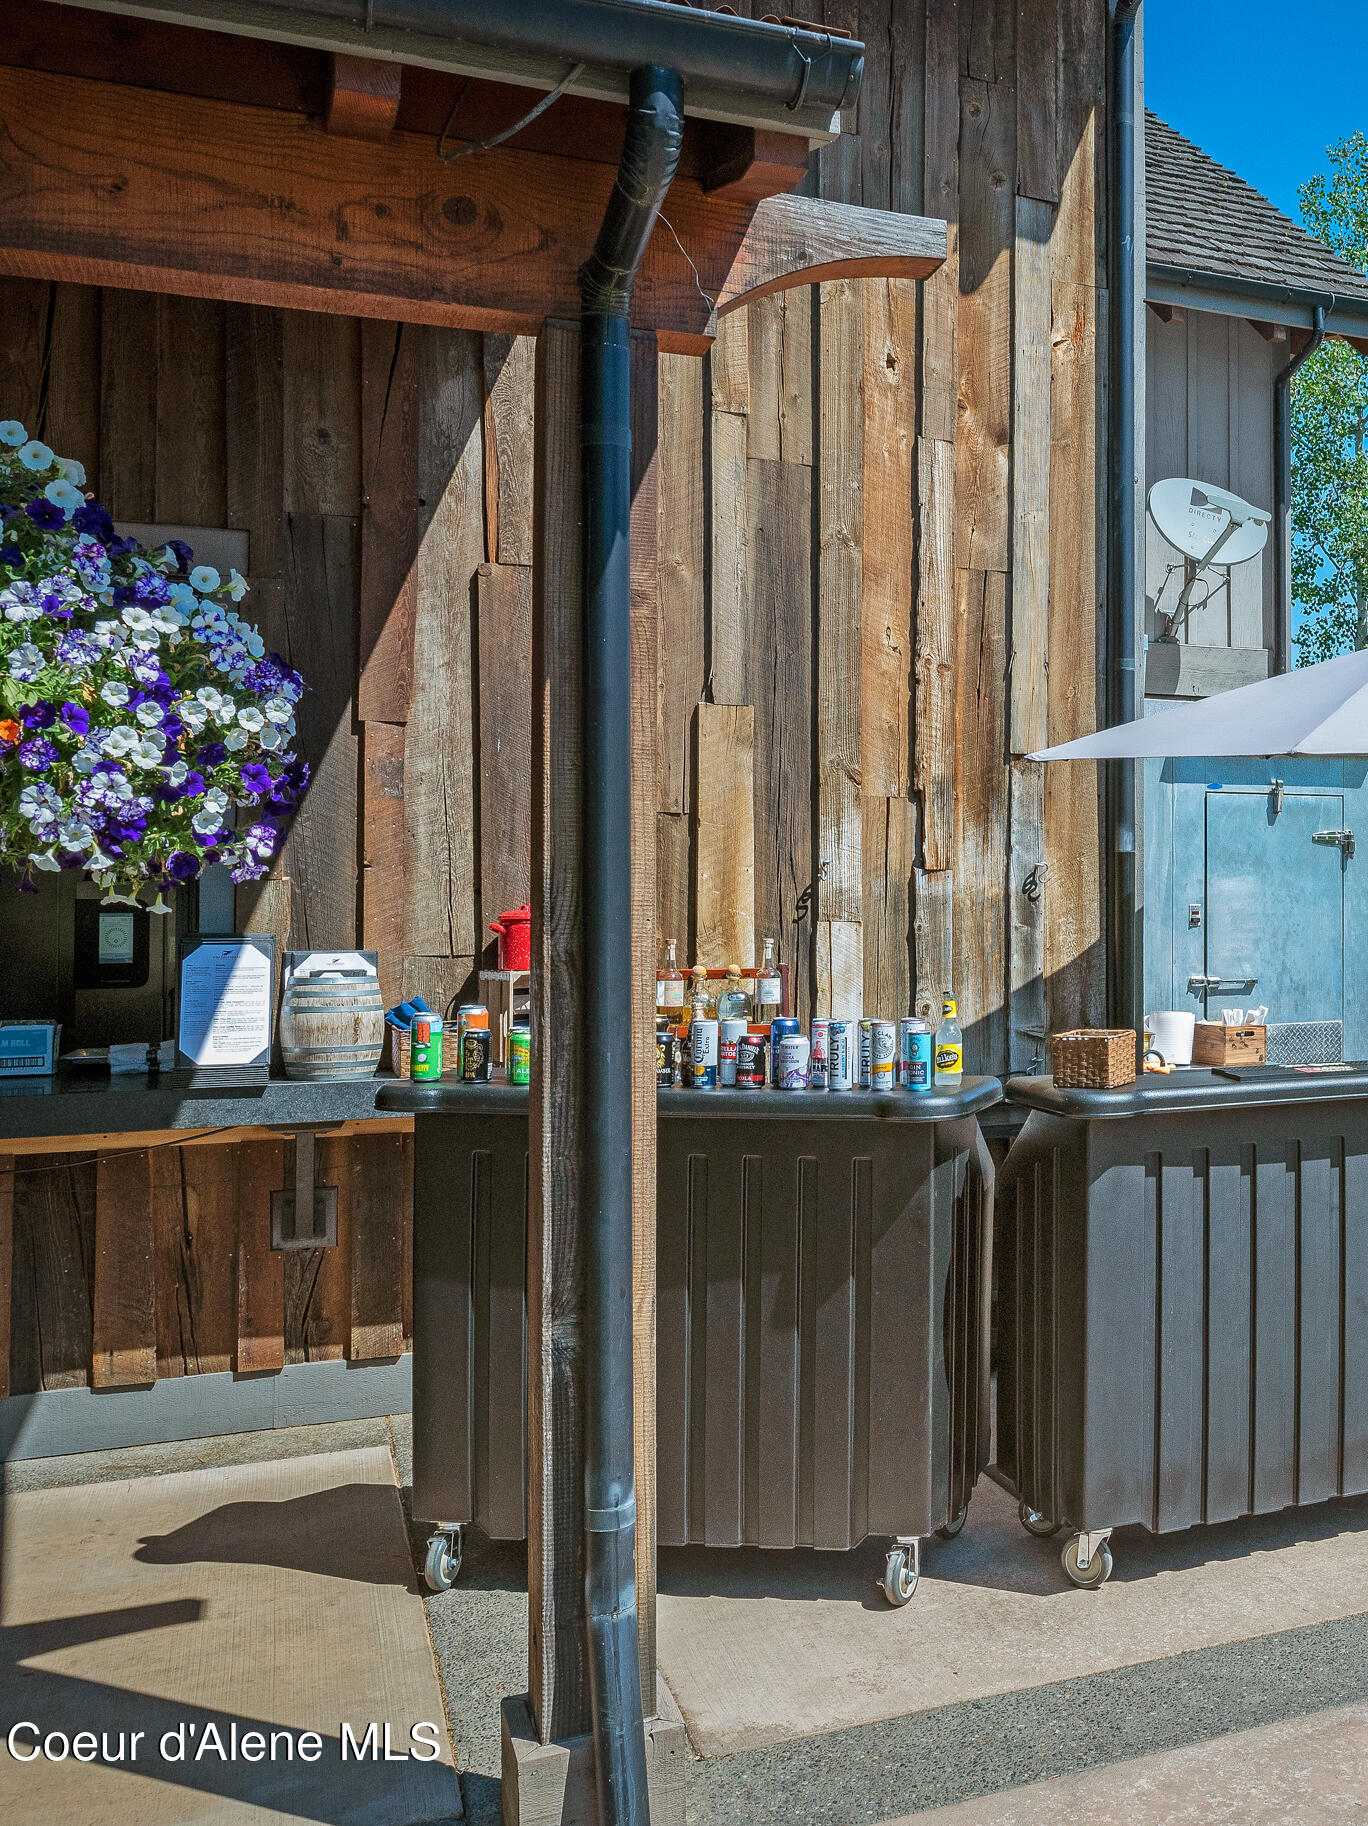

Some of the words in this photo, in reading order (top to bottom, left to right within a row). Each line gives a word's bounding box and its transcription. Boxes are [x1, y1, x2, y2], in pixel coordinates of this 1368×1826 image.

[11, 1039, 31, 1048] ROLL
[694, 1028, 704, 1064] Corona
[829, 1037, 839, 1079] TRULY
[861, 1034, 870, 1076] TRULY
